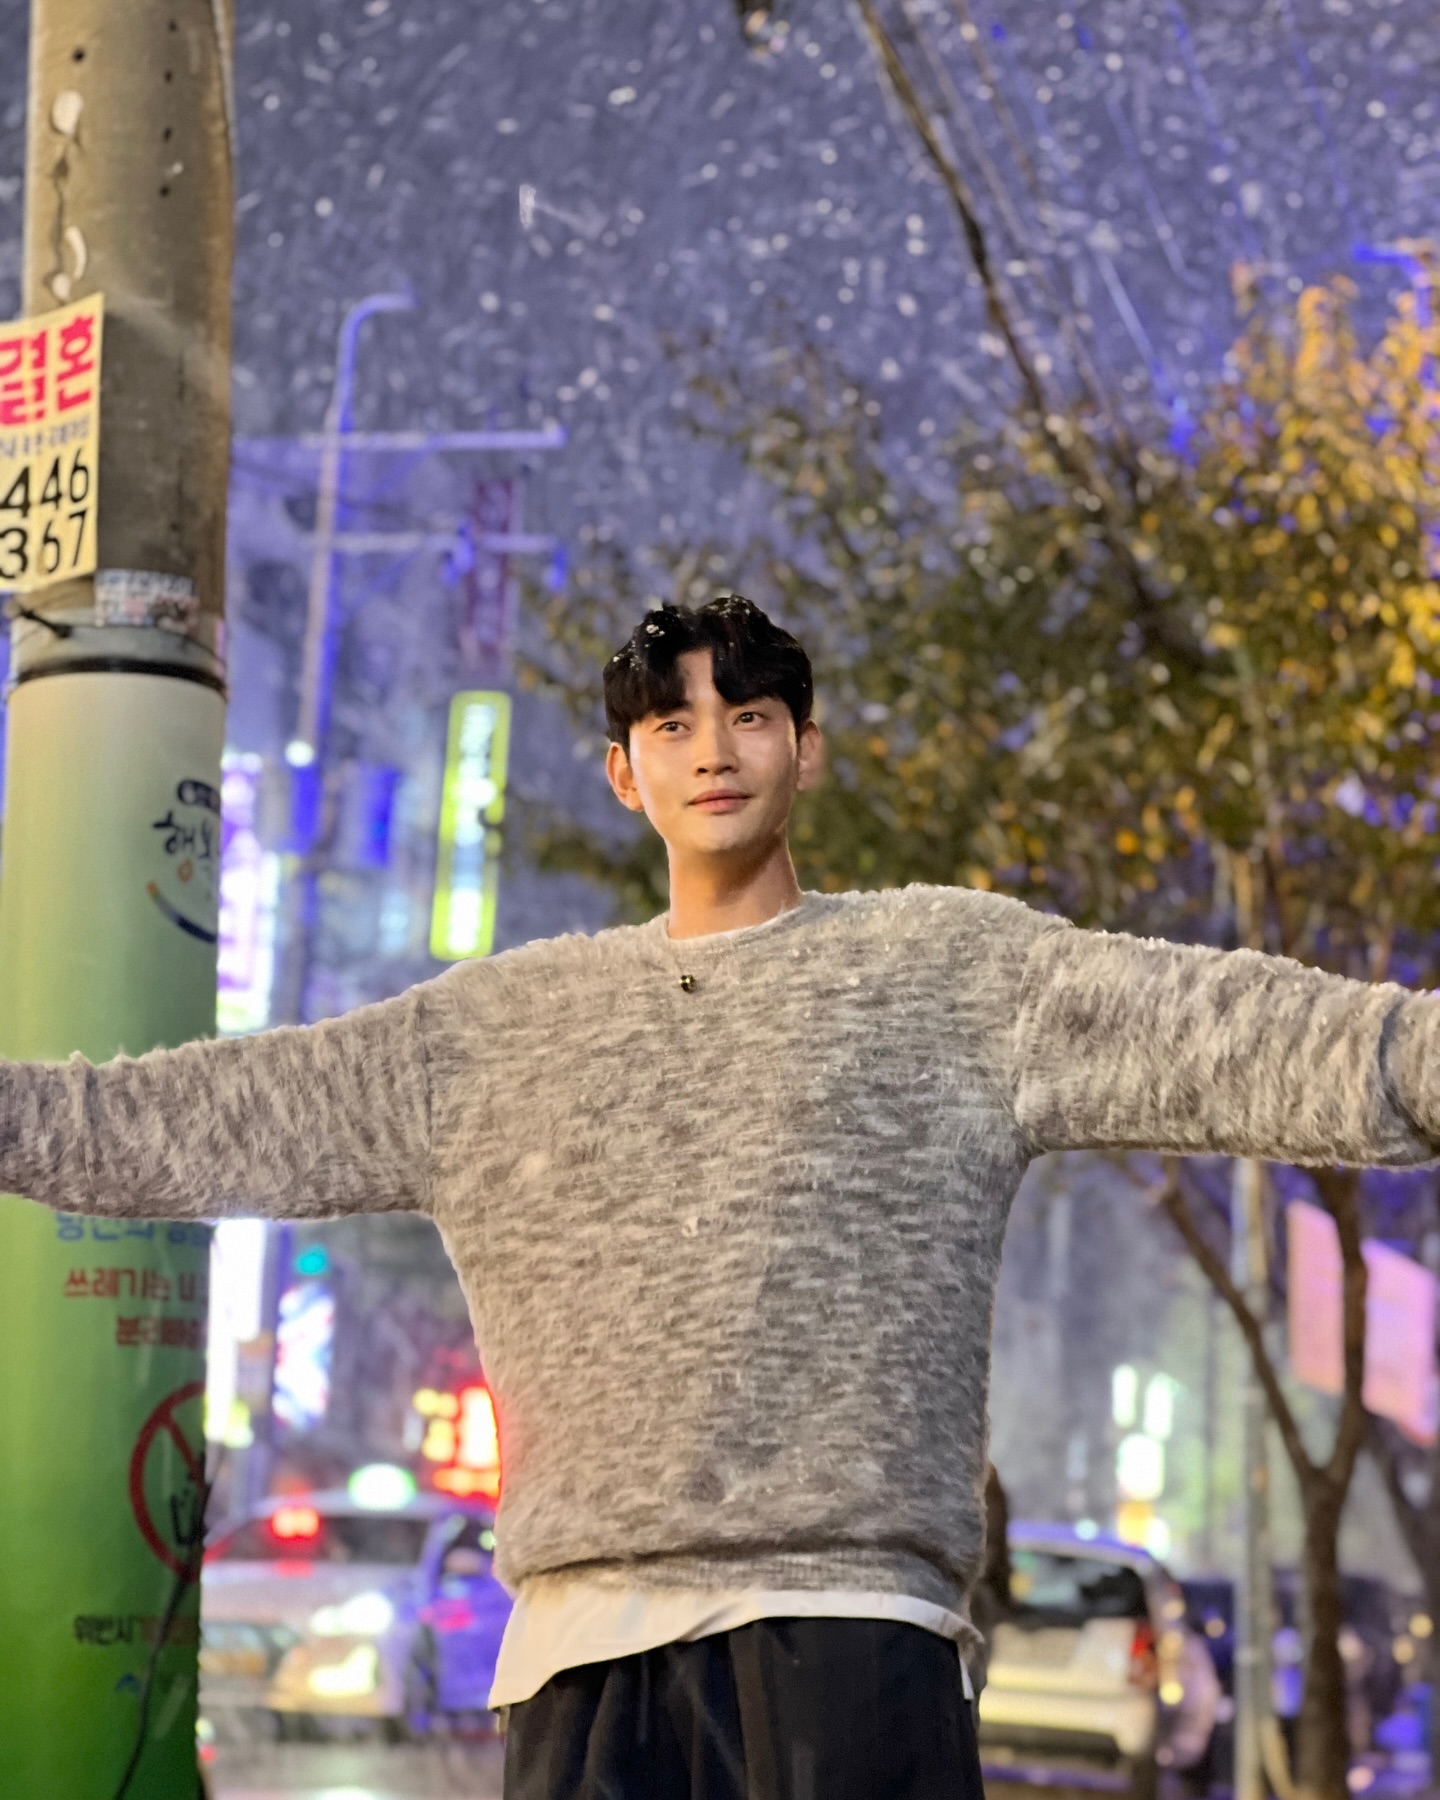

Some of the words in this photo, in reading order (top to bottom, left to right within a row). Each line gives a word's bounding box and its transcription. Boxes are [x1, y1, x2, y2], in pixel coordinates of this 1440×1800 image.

[0, 316, 94, 426] 결혼
[0, 447, 90, 518] 446
[0, 509, 88, 579] 367
